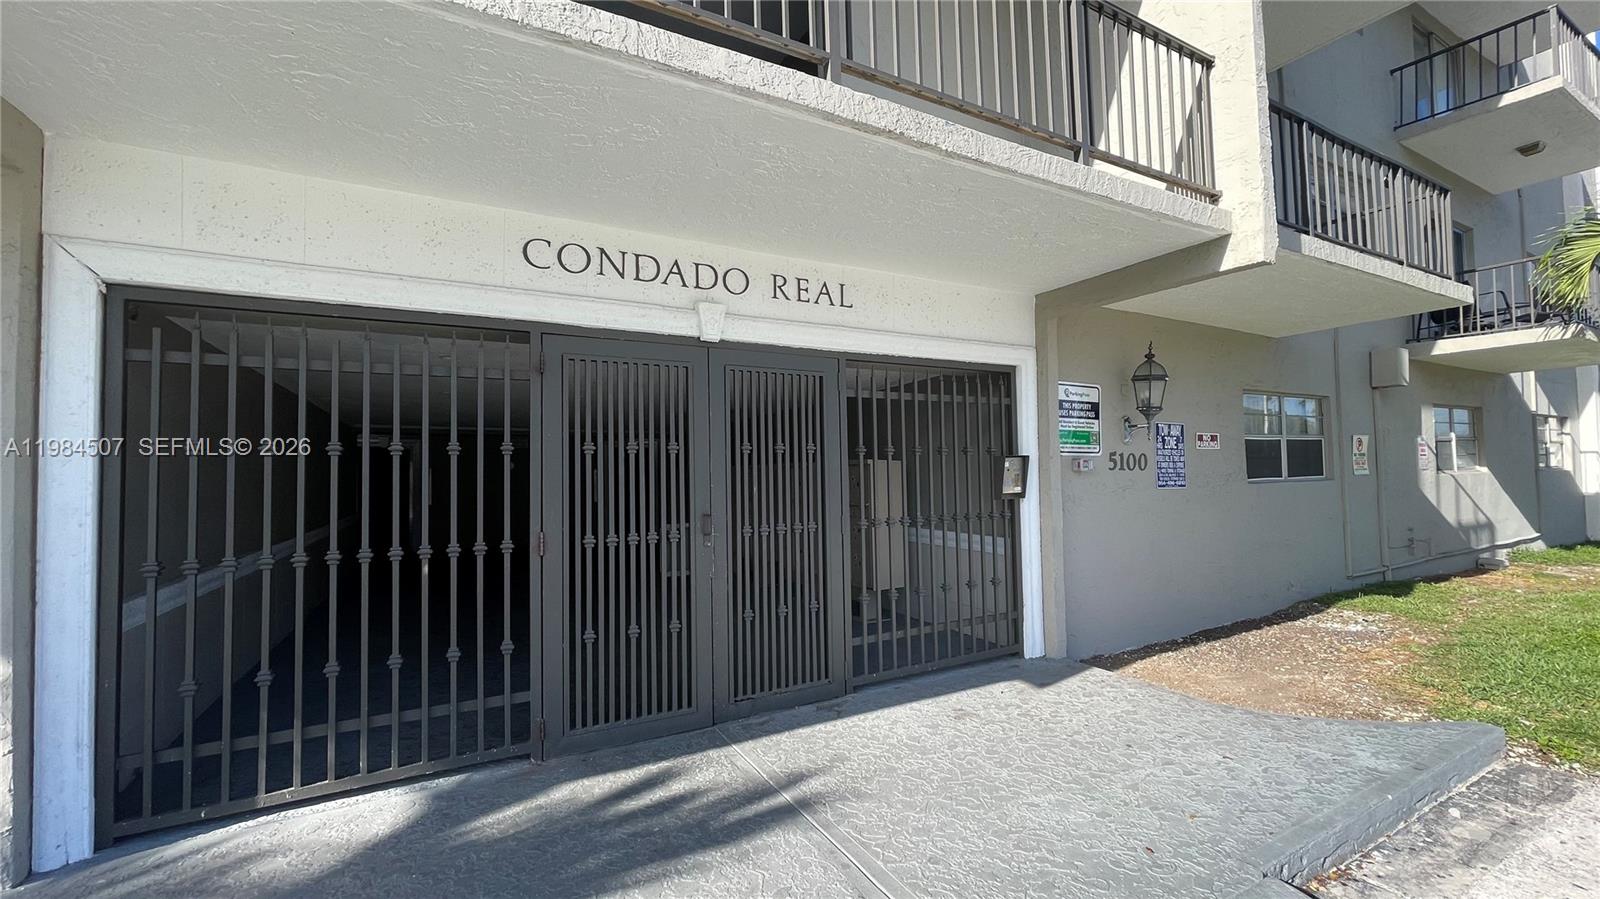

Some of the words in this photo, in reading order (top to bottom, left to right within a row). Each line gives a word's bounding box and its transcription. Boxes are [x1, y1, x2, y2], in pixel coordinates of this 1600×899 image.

[521, 237, 750, 296] CONDADO
[770, 273, 854, 309] REAL
[1164, 436, 1178, 449] ZONE
[1197, 440, 1217, 448] PARKING
[1202, 434, 1211, 442] NO
[1108, 451, 1148, 472] 5100
